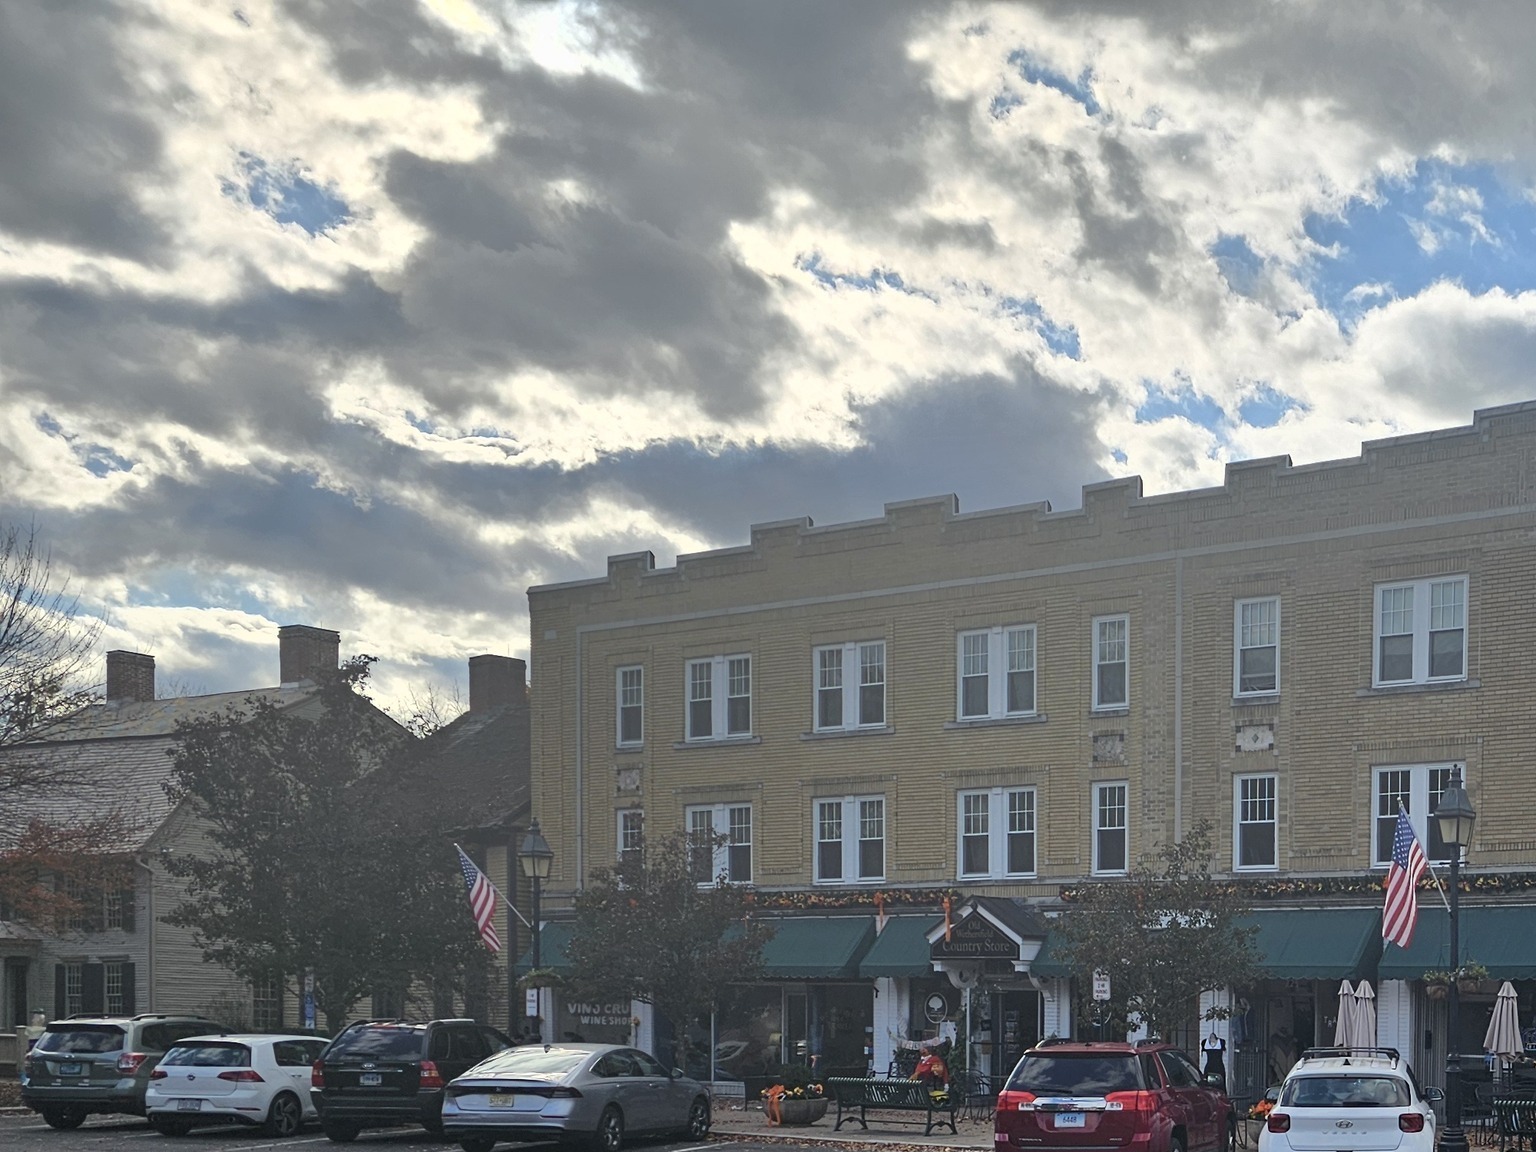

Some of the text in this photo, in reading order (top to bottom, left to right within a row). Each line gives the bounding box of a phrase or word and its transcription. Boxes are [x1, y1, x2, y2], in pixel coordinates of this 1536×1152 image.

[942, 937, 1010, 955] Country Store
[580, 1016, 607, 1025] WINE
